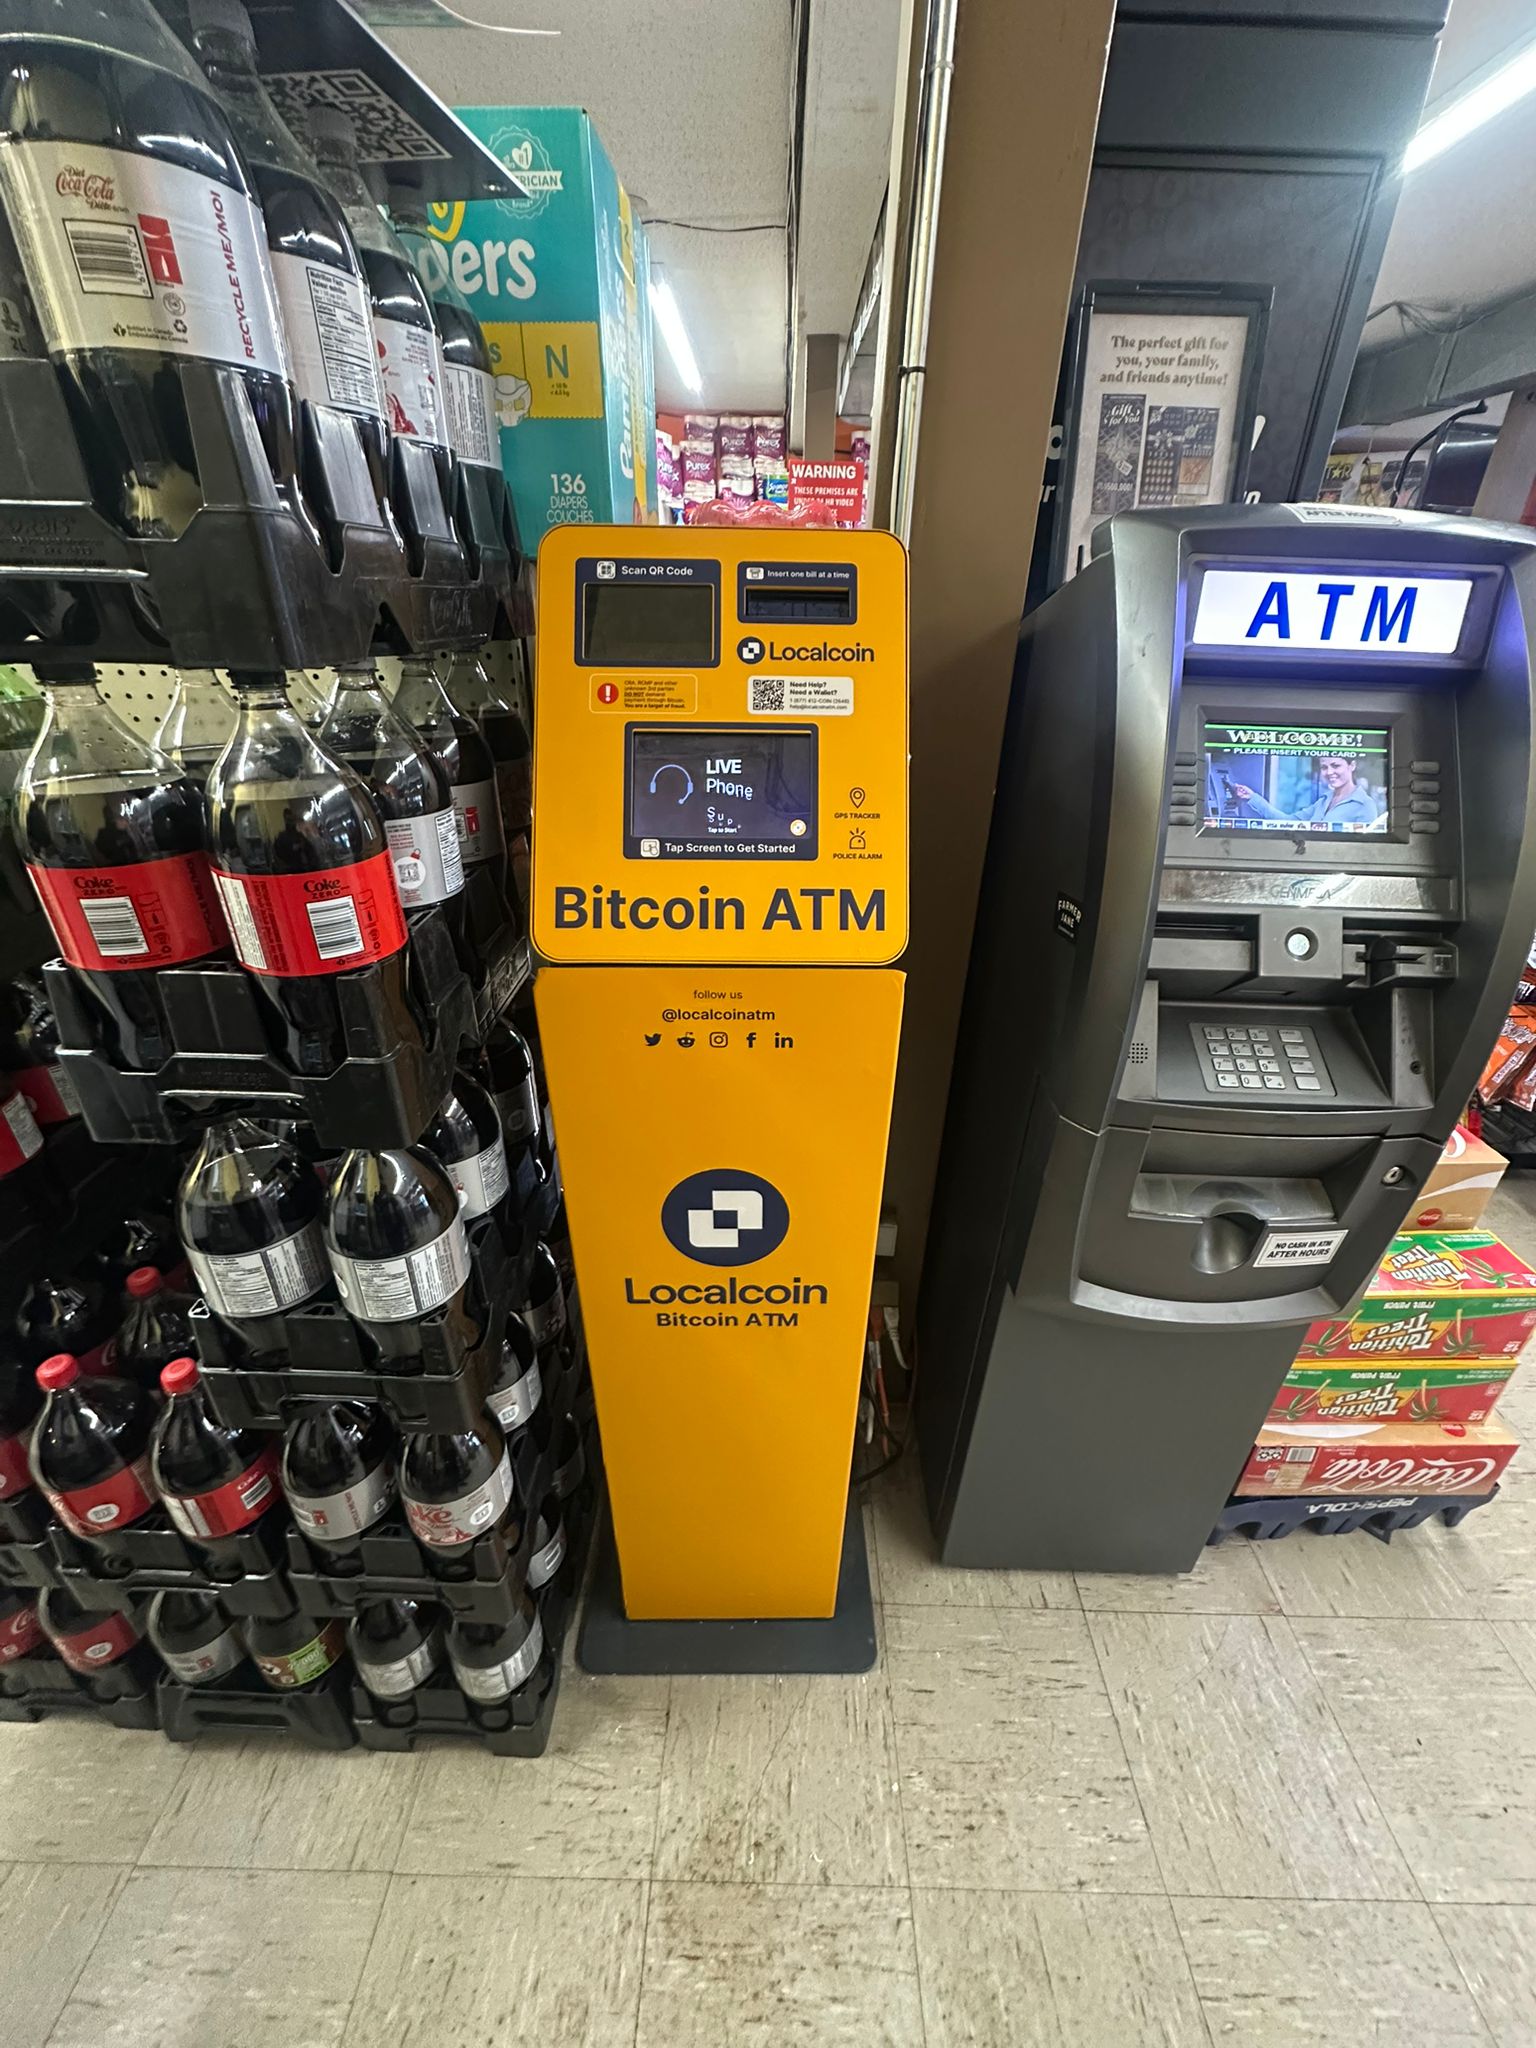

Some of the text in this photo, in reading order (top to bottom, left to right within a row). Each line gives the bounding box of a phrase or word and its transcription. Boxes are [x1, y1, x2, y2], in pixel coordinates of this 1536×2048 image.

[513, 175, 559, 187] RICIAN
[210, 190, 256, 359] RECYCLE ME/MOI
[418, 238, 537, 300] pers
[1111, 335, 1229, 353] The perfect gift for
[545, 344, 569, 379] N
[1116, 354, 1220, 371] you, your family,
[1100, 371, 1229, 387] and friends anytime!
[1111, 402, 1133, 417] Gift
[686, 460, 711, 472] Purex
[791, 464, 857, 479] WARNING
[550, 474, 586, 494] 136
[794, 486, 814, 495] THESE
[814, 486, 845, 496] PREMISES
[846, 487, 859, 496] ARE
[550, 496, 588, 509] DIAPERS
[835, 498, 855, 507] VIDEO
[546, 510, 594, 523] COUCHES
[621, 566, 693, 576] Scan QR Code
[1245, 581, 1419, 643] ATM
[769, 642, 875, 662] Localcoin
[1226, 729, 1364, 747] WELCOME!
[706, 759, 742, 774] LIVE
[706, 778, 753, 800] Phone
[665, 843, 796, 854] Tap Screen to Get Started
[73, 876, 115, 890] Coke
[303, 878, 342, 893] Coke
[312, 889, 341, 900] ZERO
[554, 884, 886, 931] Bitcoin ATM
[693, 989, 743, 1000] follow us
[662, 1008, 776, 1022] @localcoinatm
[1288, 1241, 1307, 1249] CASH
[1298, 1248, 1330, 1256] HOURS
[1391, 1244, 1440, 1269] Treat
[1390, 1259, 1473, 1283] Tahitian
[625, 1277, 828, 1305] Localcoin
[656, 1312, 799, 1327] Bitcoin ATM
[1368, 1312, 1429, 1339] Treat
[1349, 1330, 1436, 1351] Tahitian
[1503, 1343, 1521, 1353] 12
[1335, 1382, 1395, 1406] Treat
[1317, 1397, 1399, 1417] Tahitian
[1304, 1456, 1496, 1494] Coca-Cola
[1307, 1496, 1420, 1515] PEPSI-COLA
